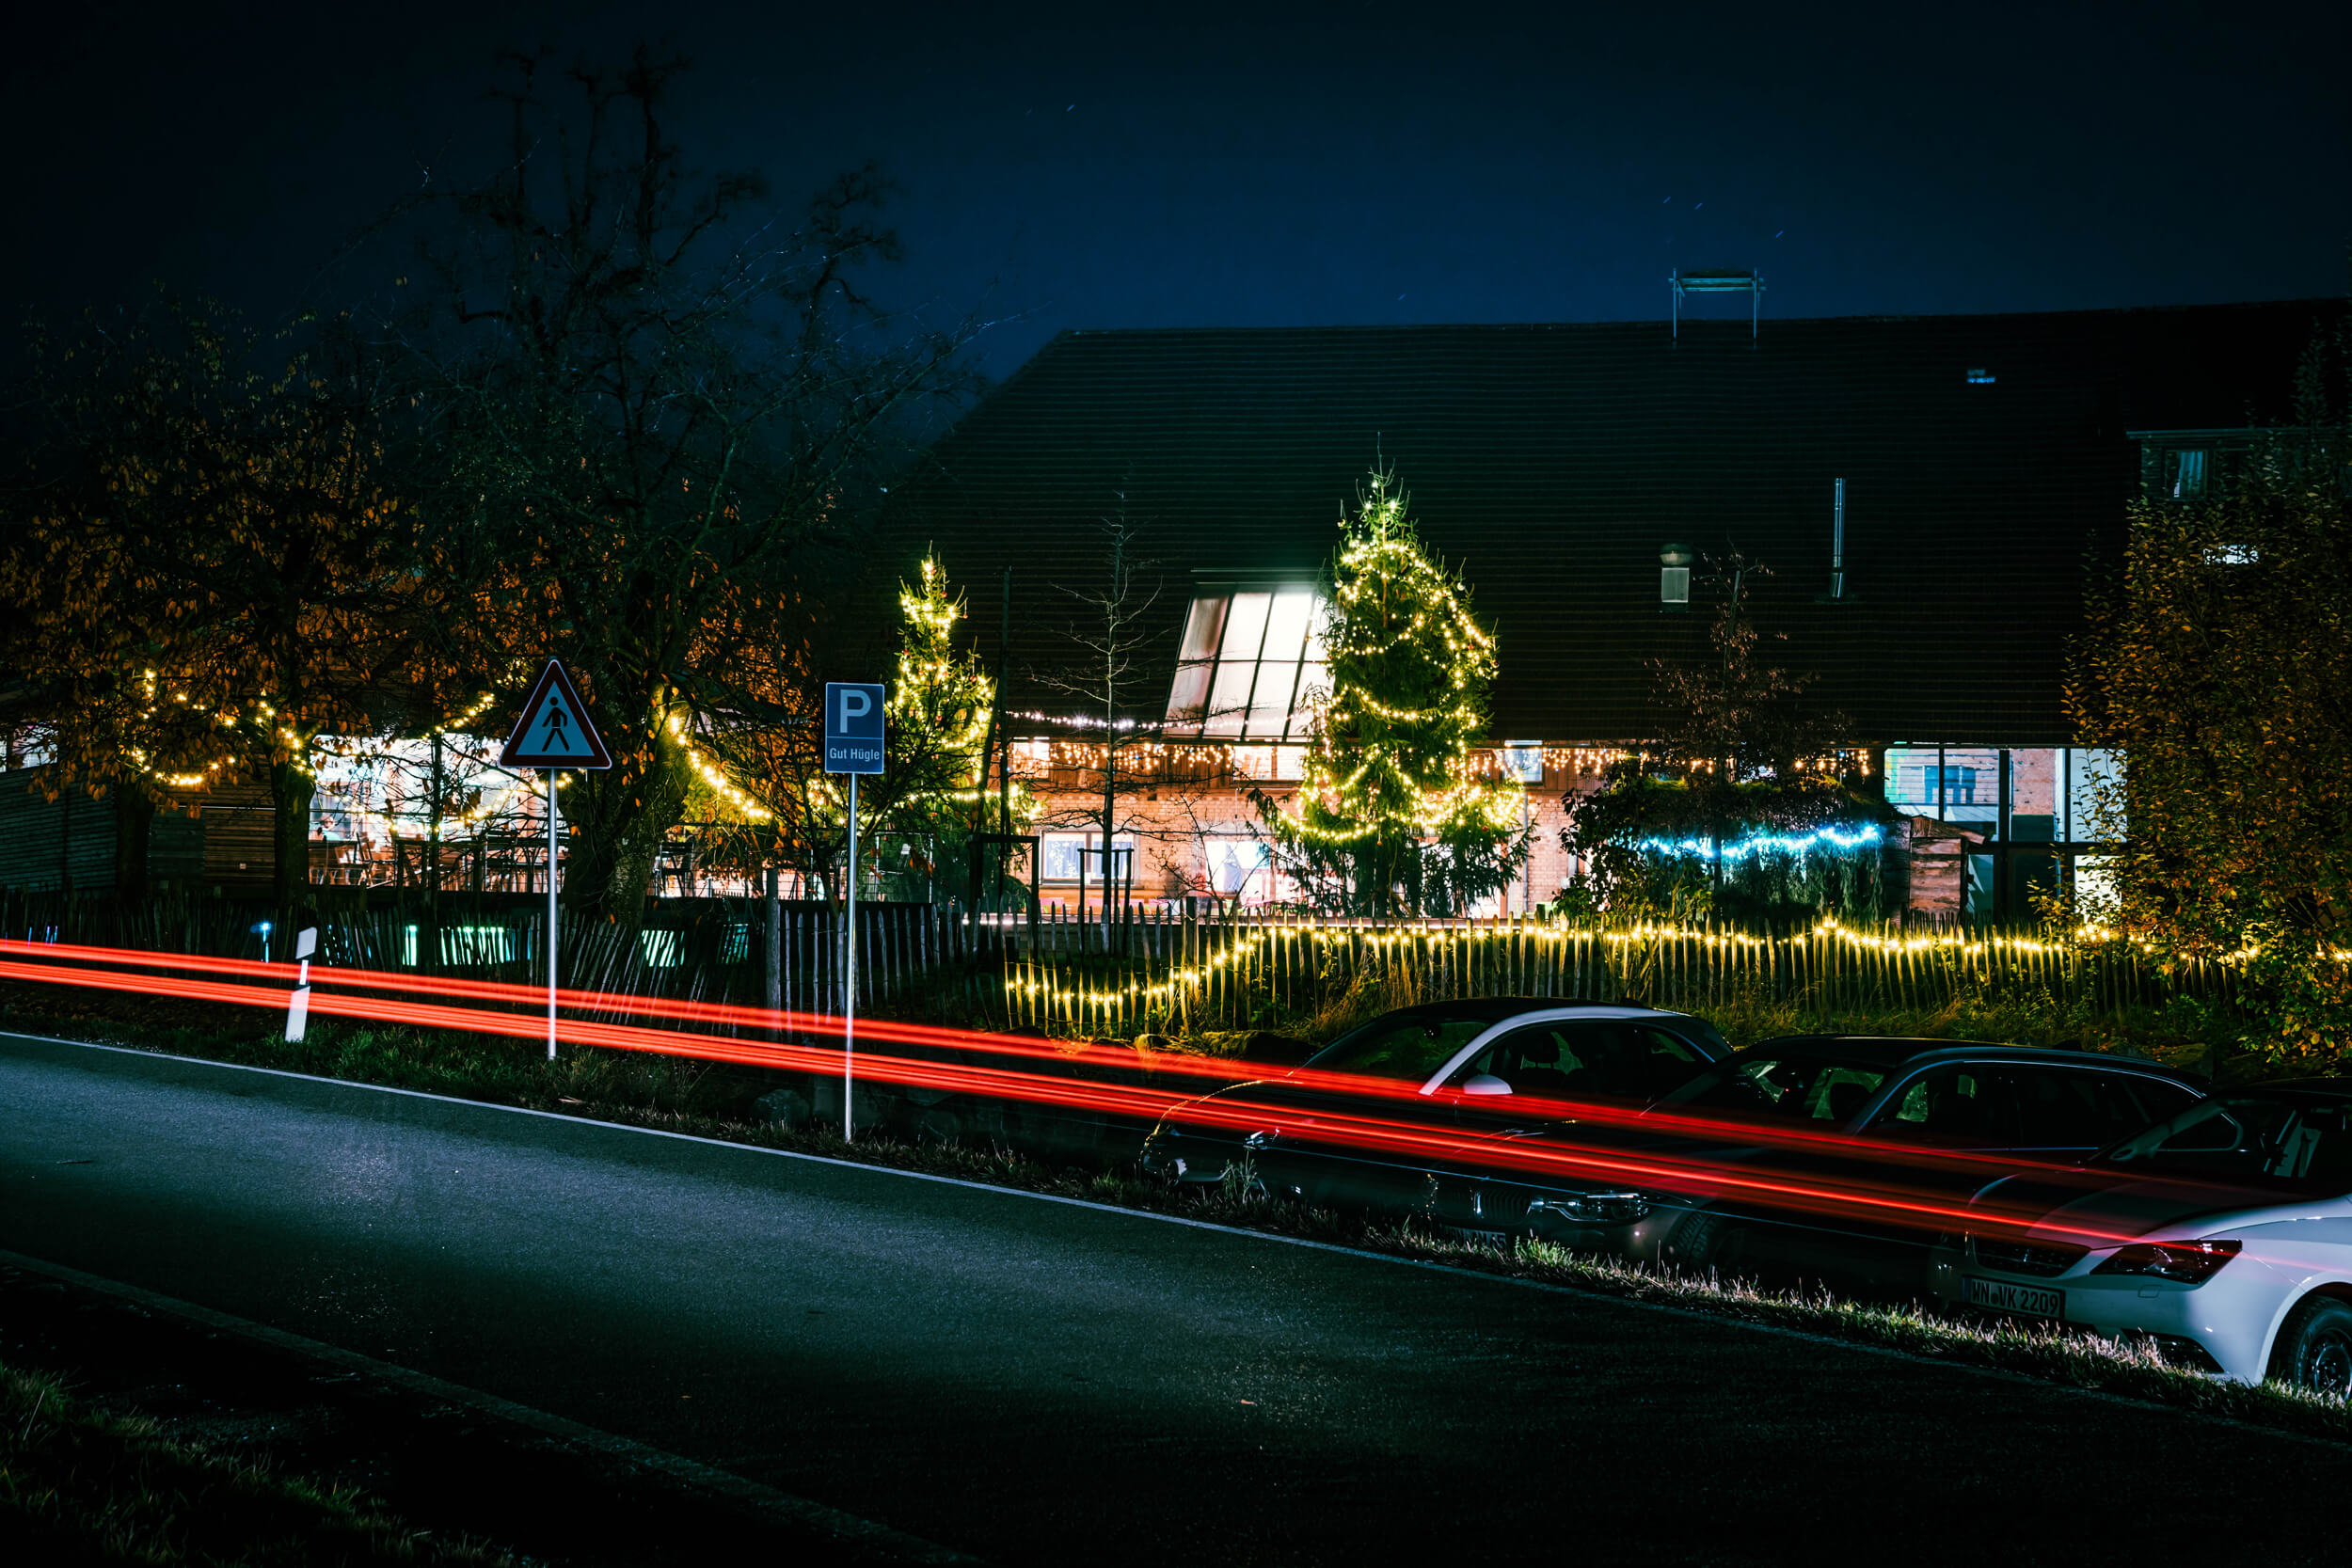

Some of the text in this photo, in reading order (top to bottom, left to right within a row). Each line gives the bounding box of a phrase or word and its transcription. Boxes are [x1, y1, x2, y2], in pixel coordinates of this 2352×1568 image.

[840, 689, 872, 733] P
[829, 748, 880, 762] Gut Hügle
[1998, 1286, 2017, 1308] VK
[2021, 1290, 2058, 1314] 2209
